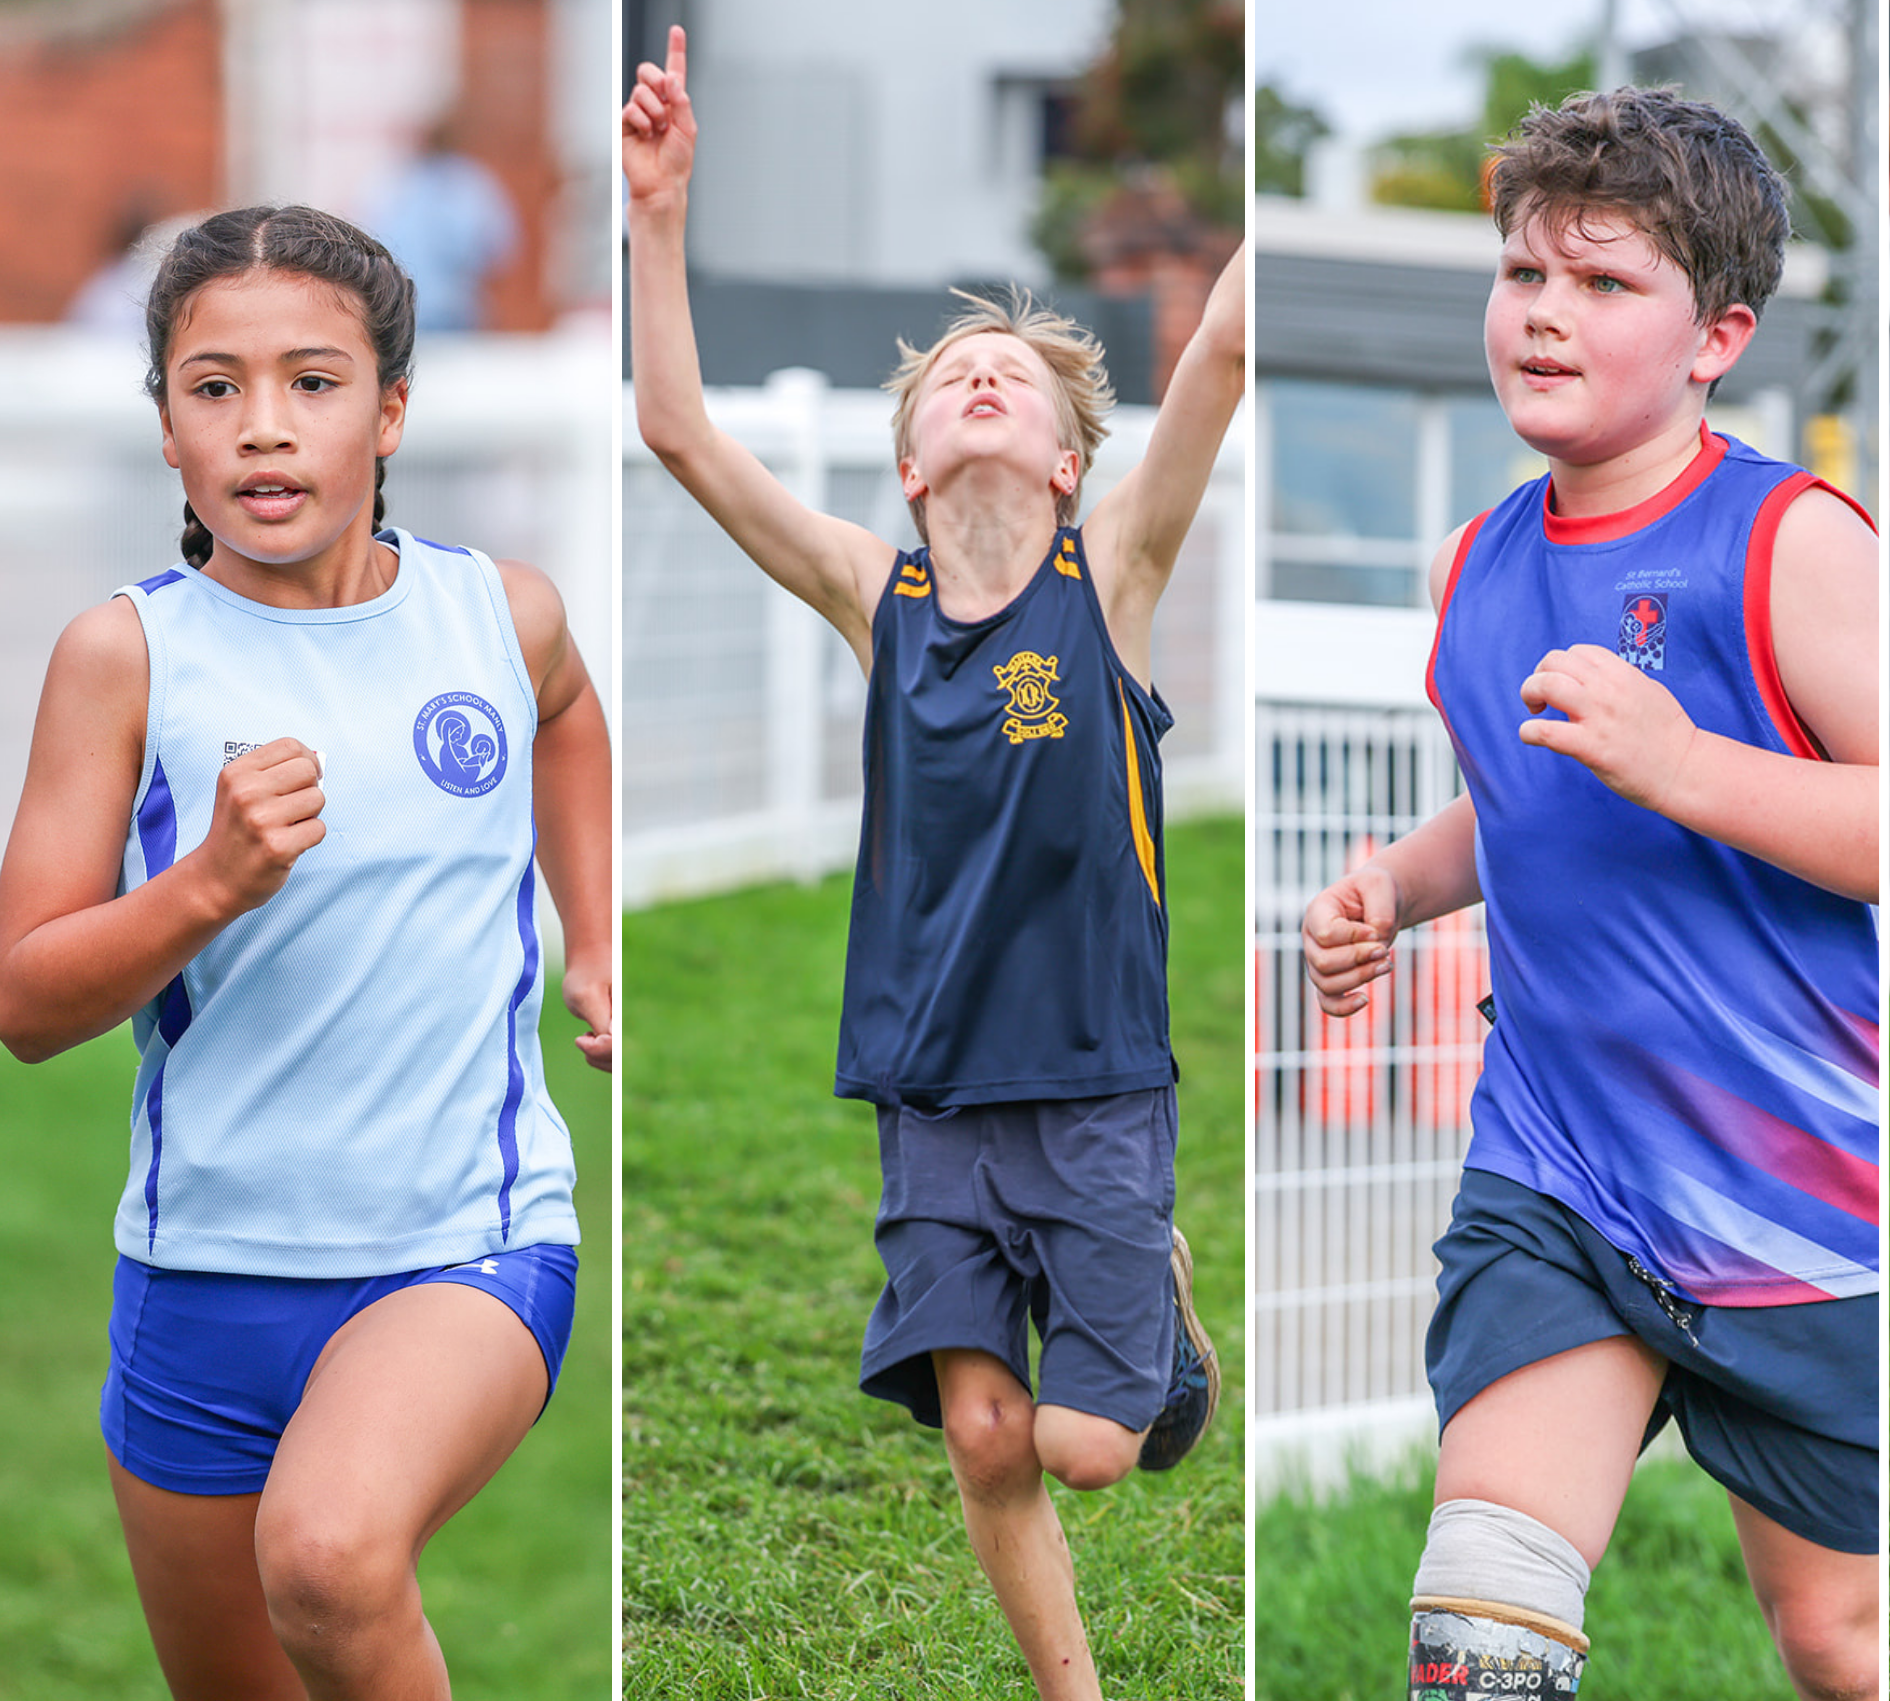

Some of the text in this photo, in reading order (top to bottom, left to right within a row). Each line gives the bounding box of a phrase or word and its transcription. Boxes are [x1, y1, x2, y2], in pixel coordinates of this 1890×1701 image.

[1653, 578, 1689, 590] School
[421, 696, 447, 720] MARY'S
[447, 694, 483, 708] SCHOOL
[483, 705, 504, 733] MANLY
[440, 776, 498, 795] LISTEN AND LOVE
[1479, 1671, 1542, 1691] C-3PO
